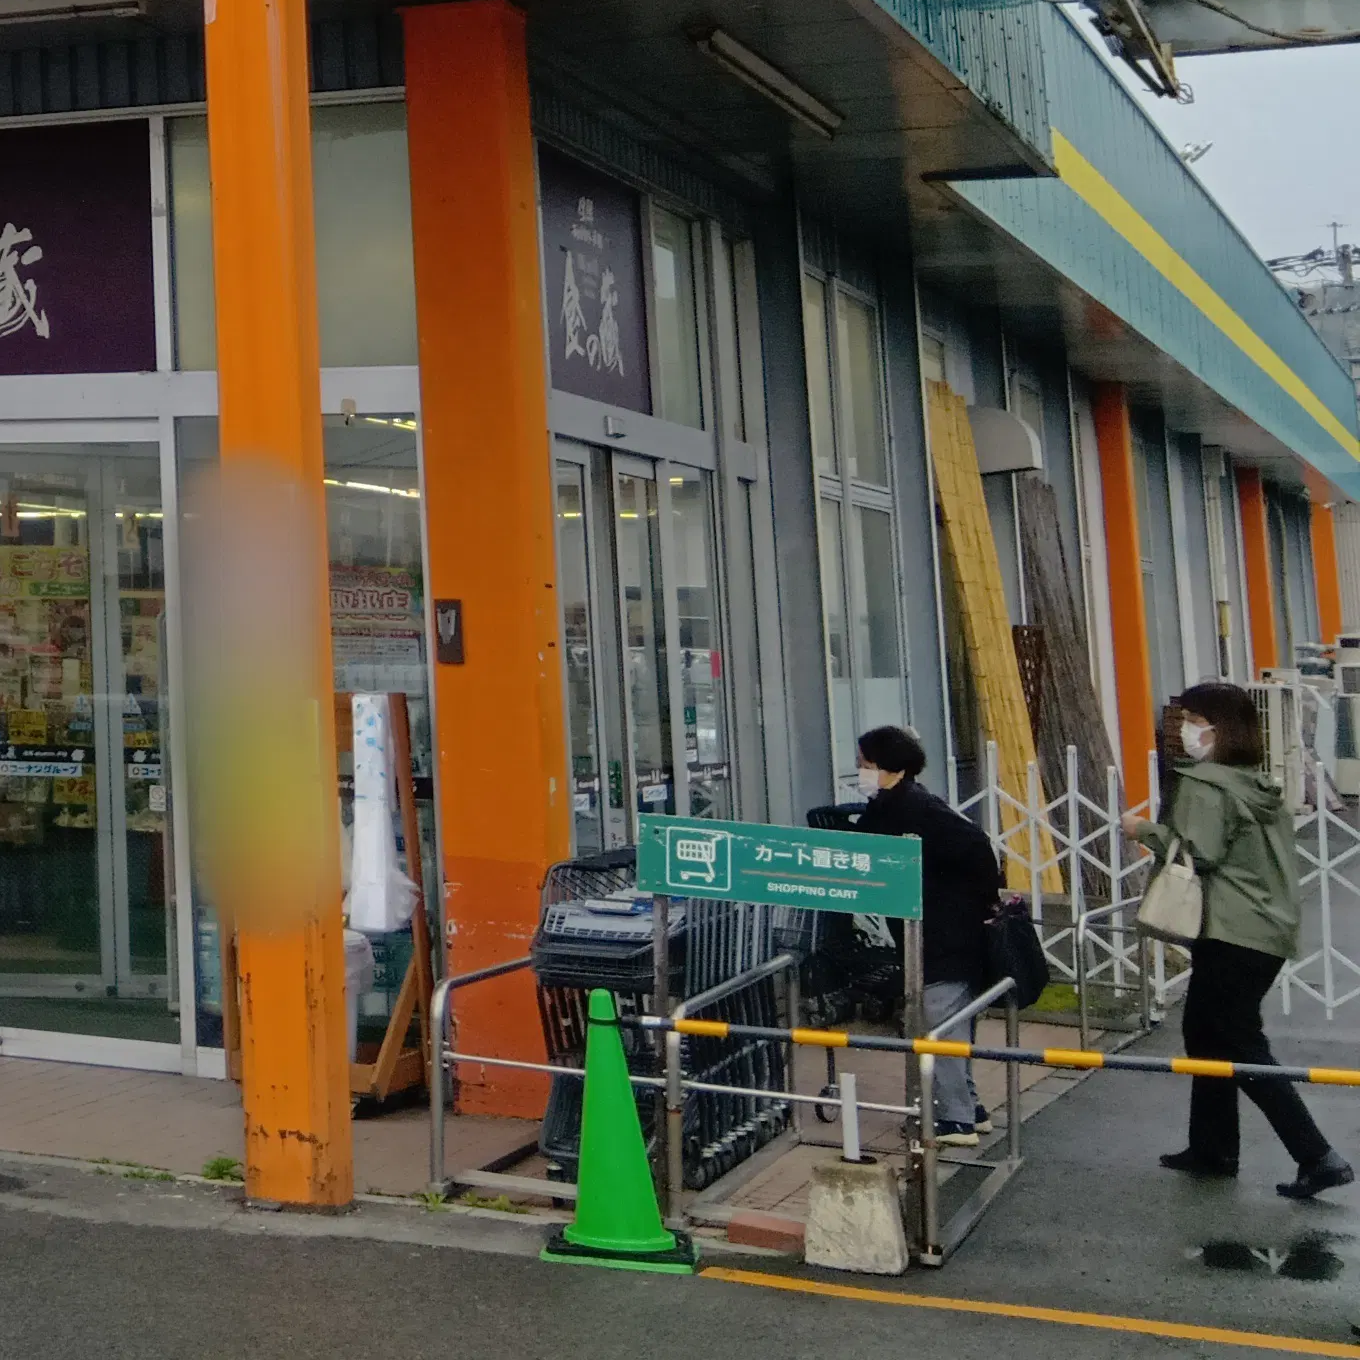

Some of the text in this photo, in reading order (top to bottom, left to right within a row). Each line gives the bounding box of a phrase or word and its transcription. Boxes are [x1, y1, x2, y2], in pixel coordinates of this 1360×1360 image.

[10, 763, 79, 775] コーナングループ
[755, 844, 872, 873] カート置き場
[767, 882, 858, 900] SHOPPING CART
